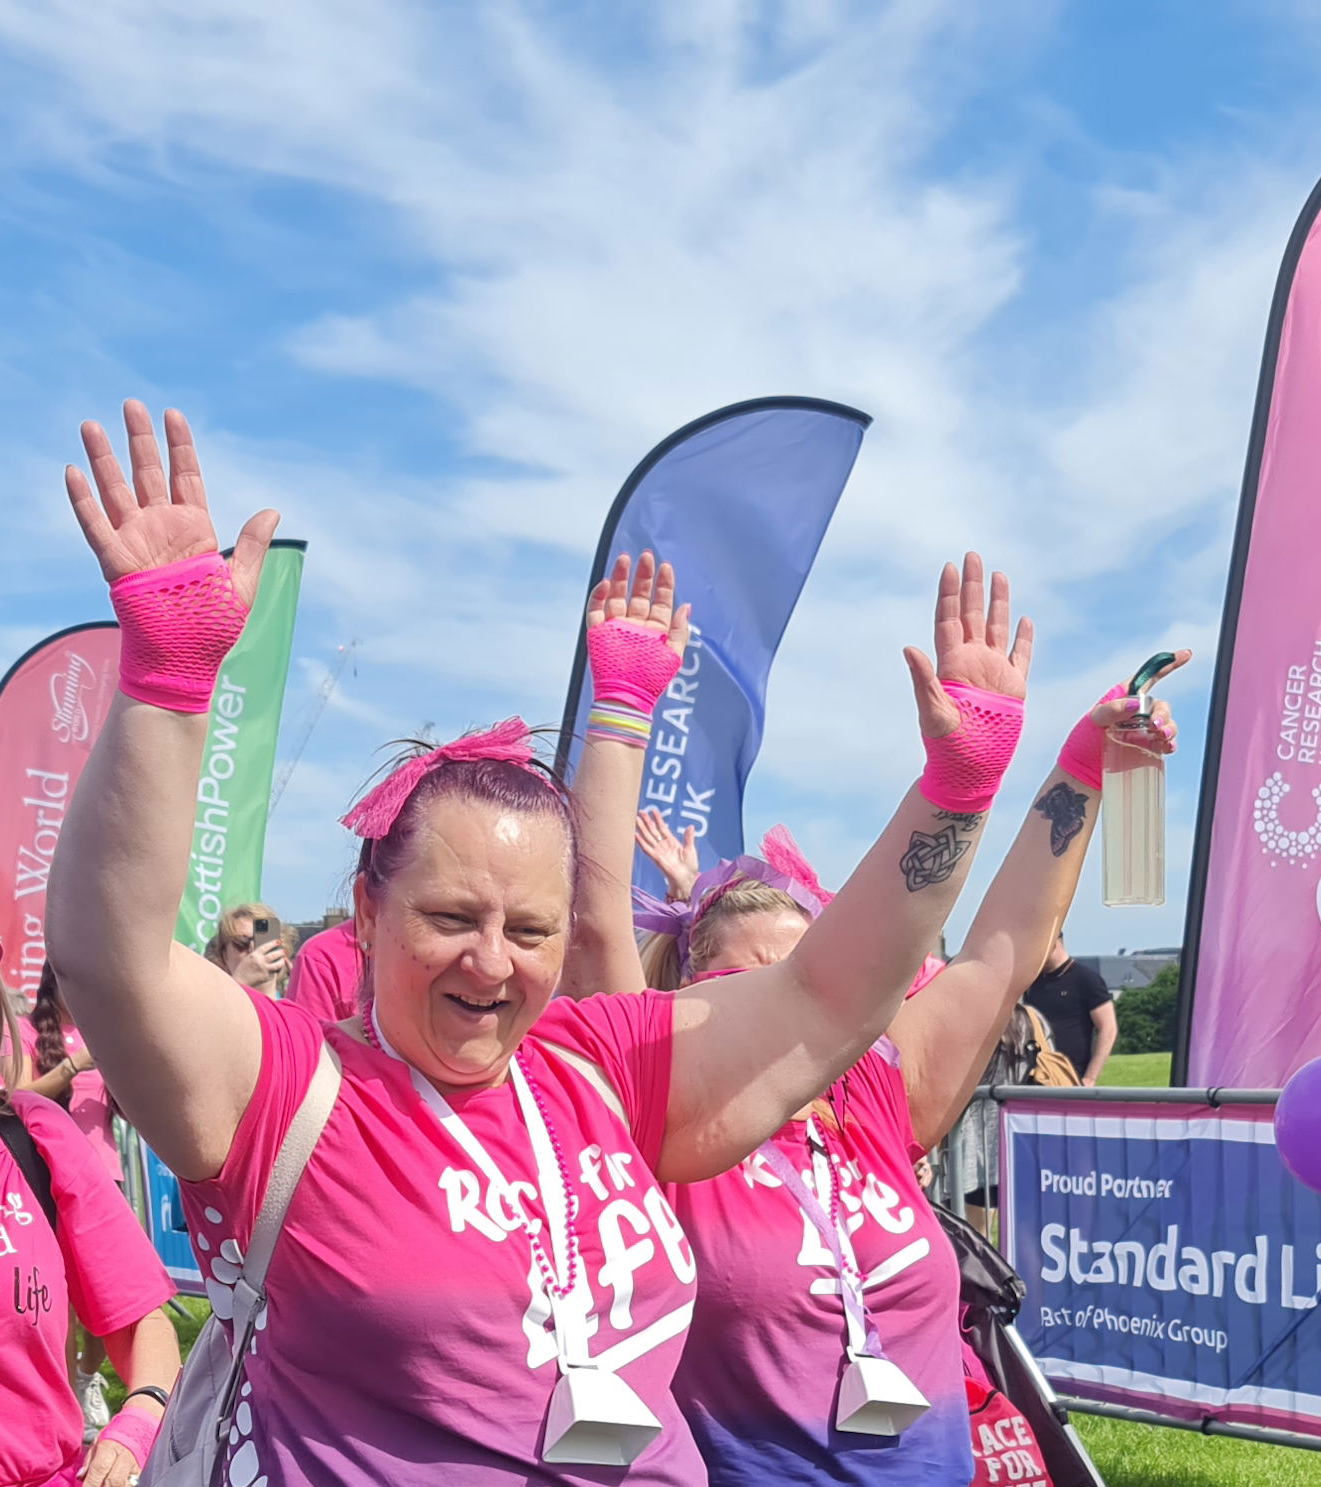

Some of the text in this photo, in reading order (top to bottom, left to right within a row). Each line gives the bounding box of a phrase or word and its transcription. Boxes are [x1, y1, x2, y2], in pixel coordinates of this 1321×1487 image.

[1277, 665, 1307, 760] CANCER
[191, 675, 247, 956] cottishPower
[677, 782, 716, 837] UK
[1040, 1168, 1173, 1199] Proud Partner
[1040, 1224, 1269, 1305] Standard
[1075, 1305, 1094, 1329] of
[1093, 1307, 1166, 1339] Phoenix
[1167, 1318, 1228, 1354] Group
[984, 1449, 1043, 1483] FOR
